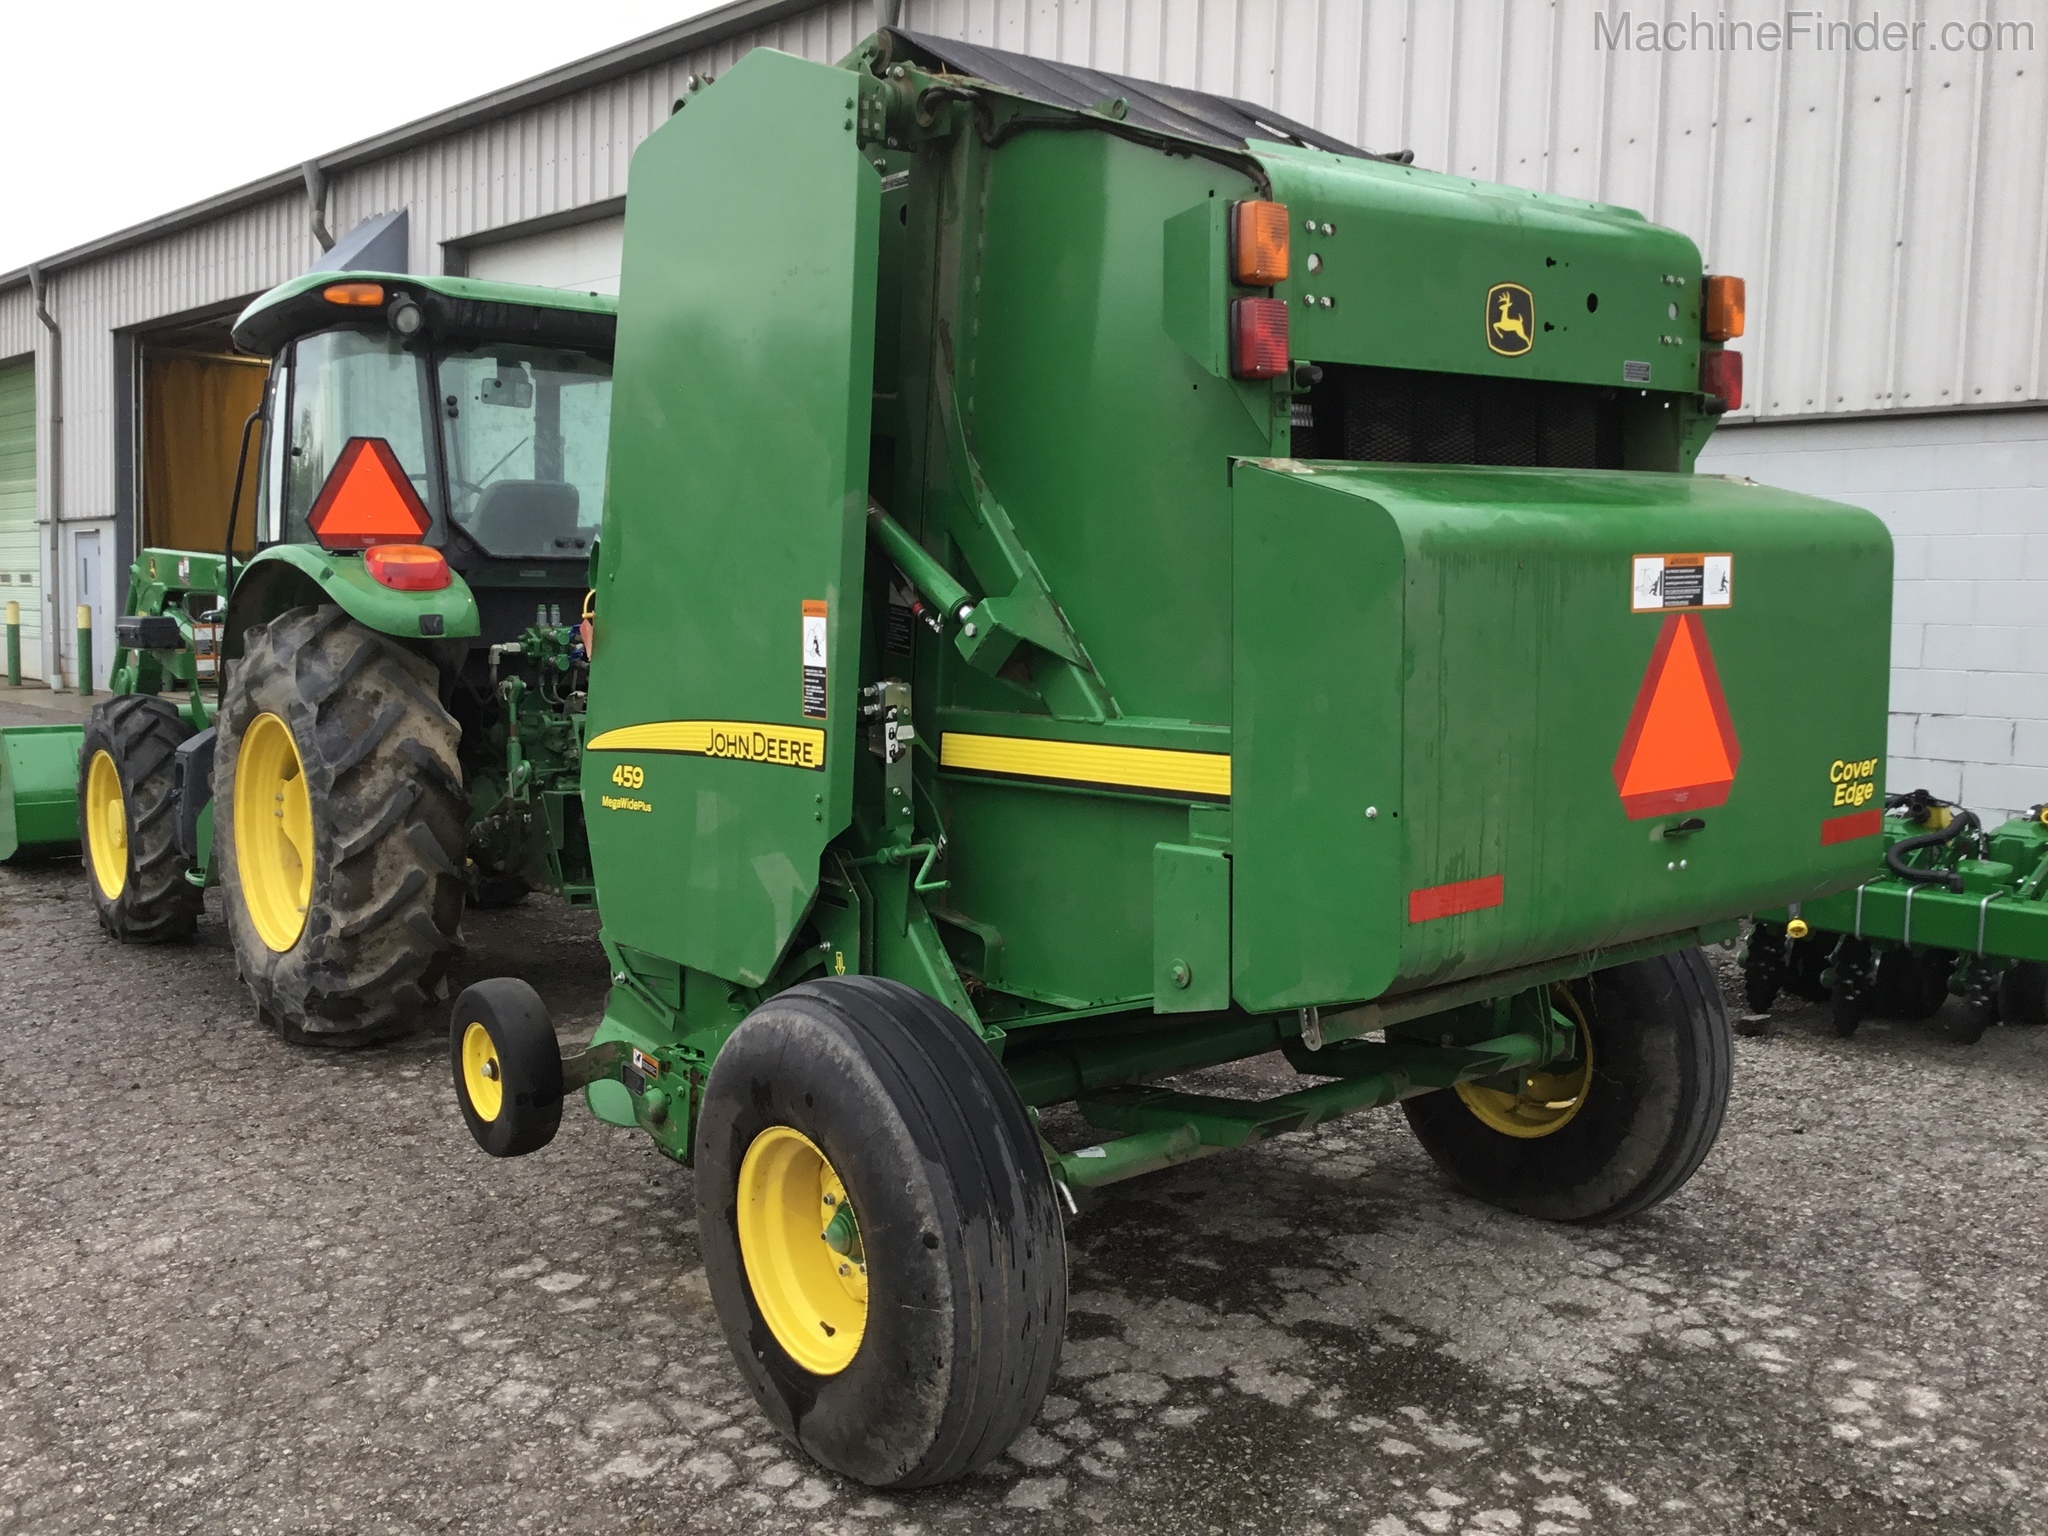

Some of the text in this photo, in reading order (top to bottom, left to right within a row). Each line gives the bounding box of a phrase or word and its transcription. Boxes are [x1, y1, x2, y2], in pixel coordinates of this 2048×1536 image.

[705, 727, 814, 764] JOHN DEERE
[611, 763, 645, 790] 459
[1829, 757, 1878, 783] Cover
[601, 794, 652, 813] MegaWidePlus
[1833, 780, 1875, 807] Edge
